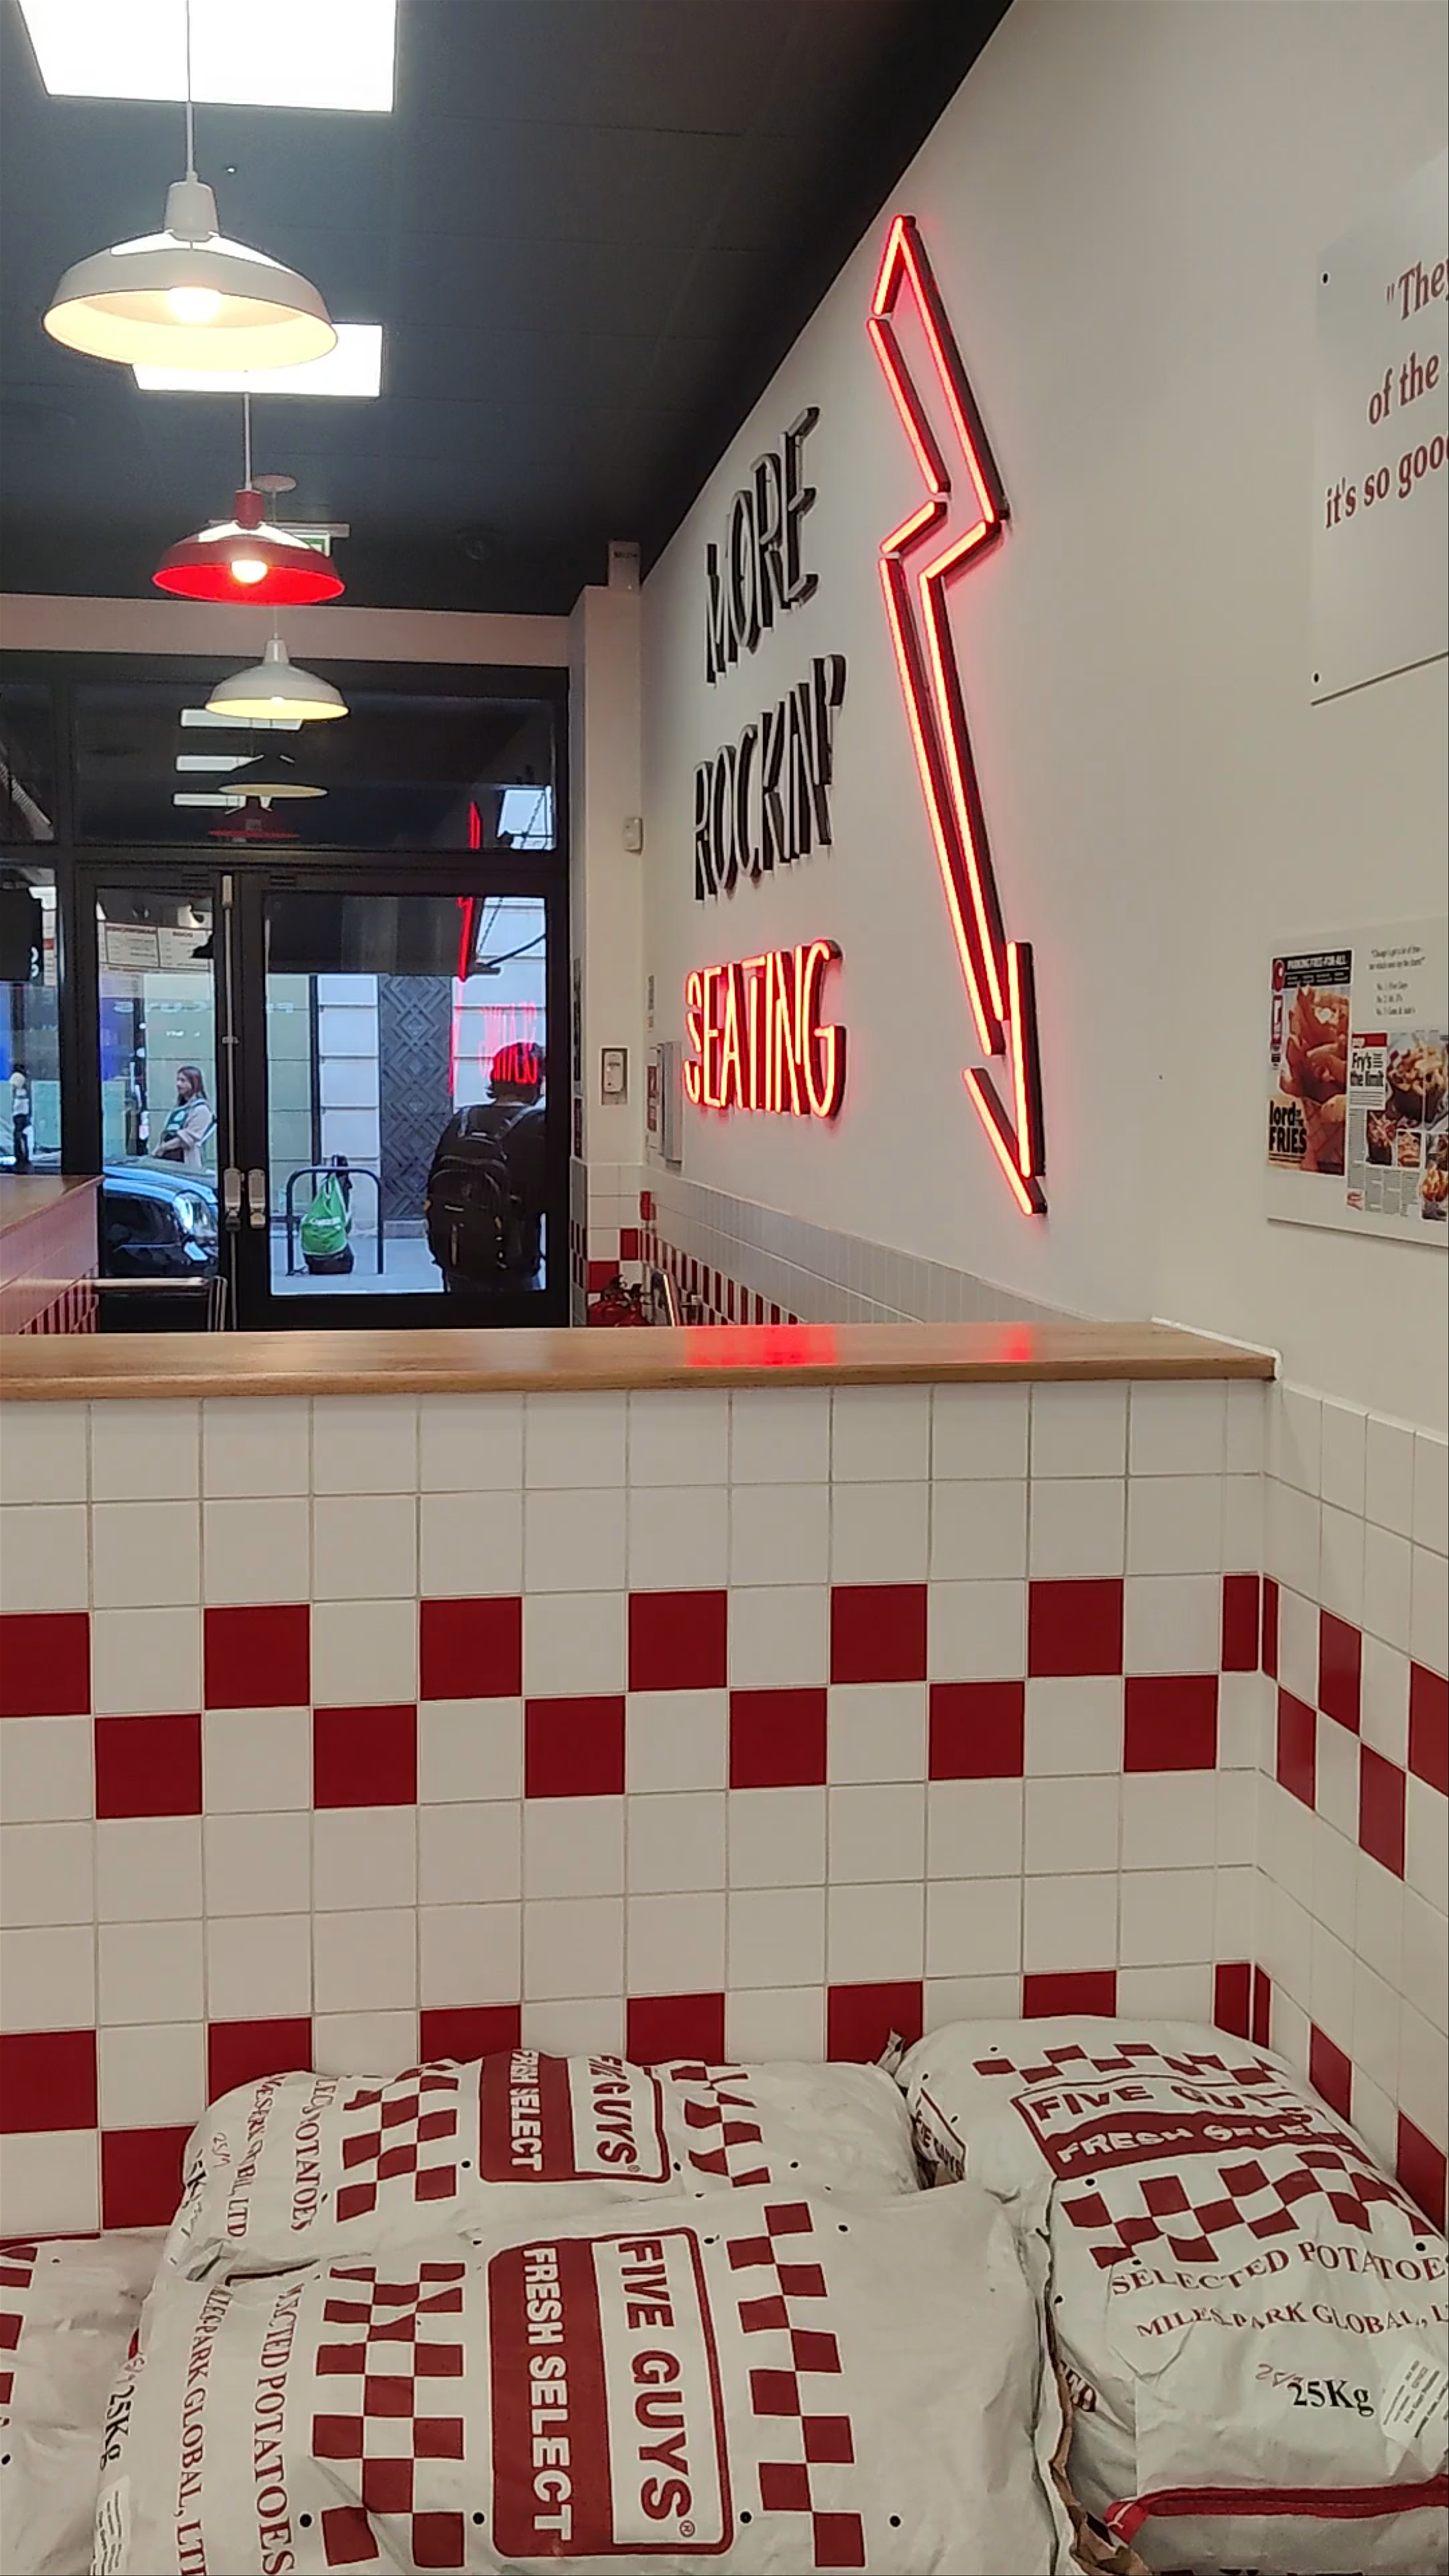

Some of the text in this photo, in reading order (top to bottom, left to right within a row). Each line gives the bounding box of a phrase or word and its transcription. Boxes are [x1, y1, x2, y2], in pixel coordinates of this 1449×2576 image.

[1386, 260, 1448, 321] "The
[1369, 351, 1439, 425] of the
[1326, 435, 1448, 529] it's so goo
[706, 406, 820, 684] MORE
[682, 939, 846, 1120] SEATING
[1350, 1070, 1363, 1087] the
[1352, 1052, 1372, 1072] Fry's
[1269, 1126, 1307, 1153] FRIES
[1270, 1100, 1296, 1126] lord
[509, 2087, 543, 2172] SELECT
[1029, 2086, 1154, 2121] FIVE
[1057, 2127, 1194, 2164] FRESH
[227, 2198, 249, 2237] LTD
[618, 2239, 675, 2330] FIVE
[1112, 2241, 1448, 2295] SELECTED POTATOE
[523, 2247, 572, 2542] FRESH SELECT
[1287, 2379, 1374, 2418] 25Kg
[253, 2374, 295, 2575] POTATOES
